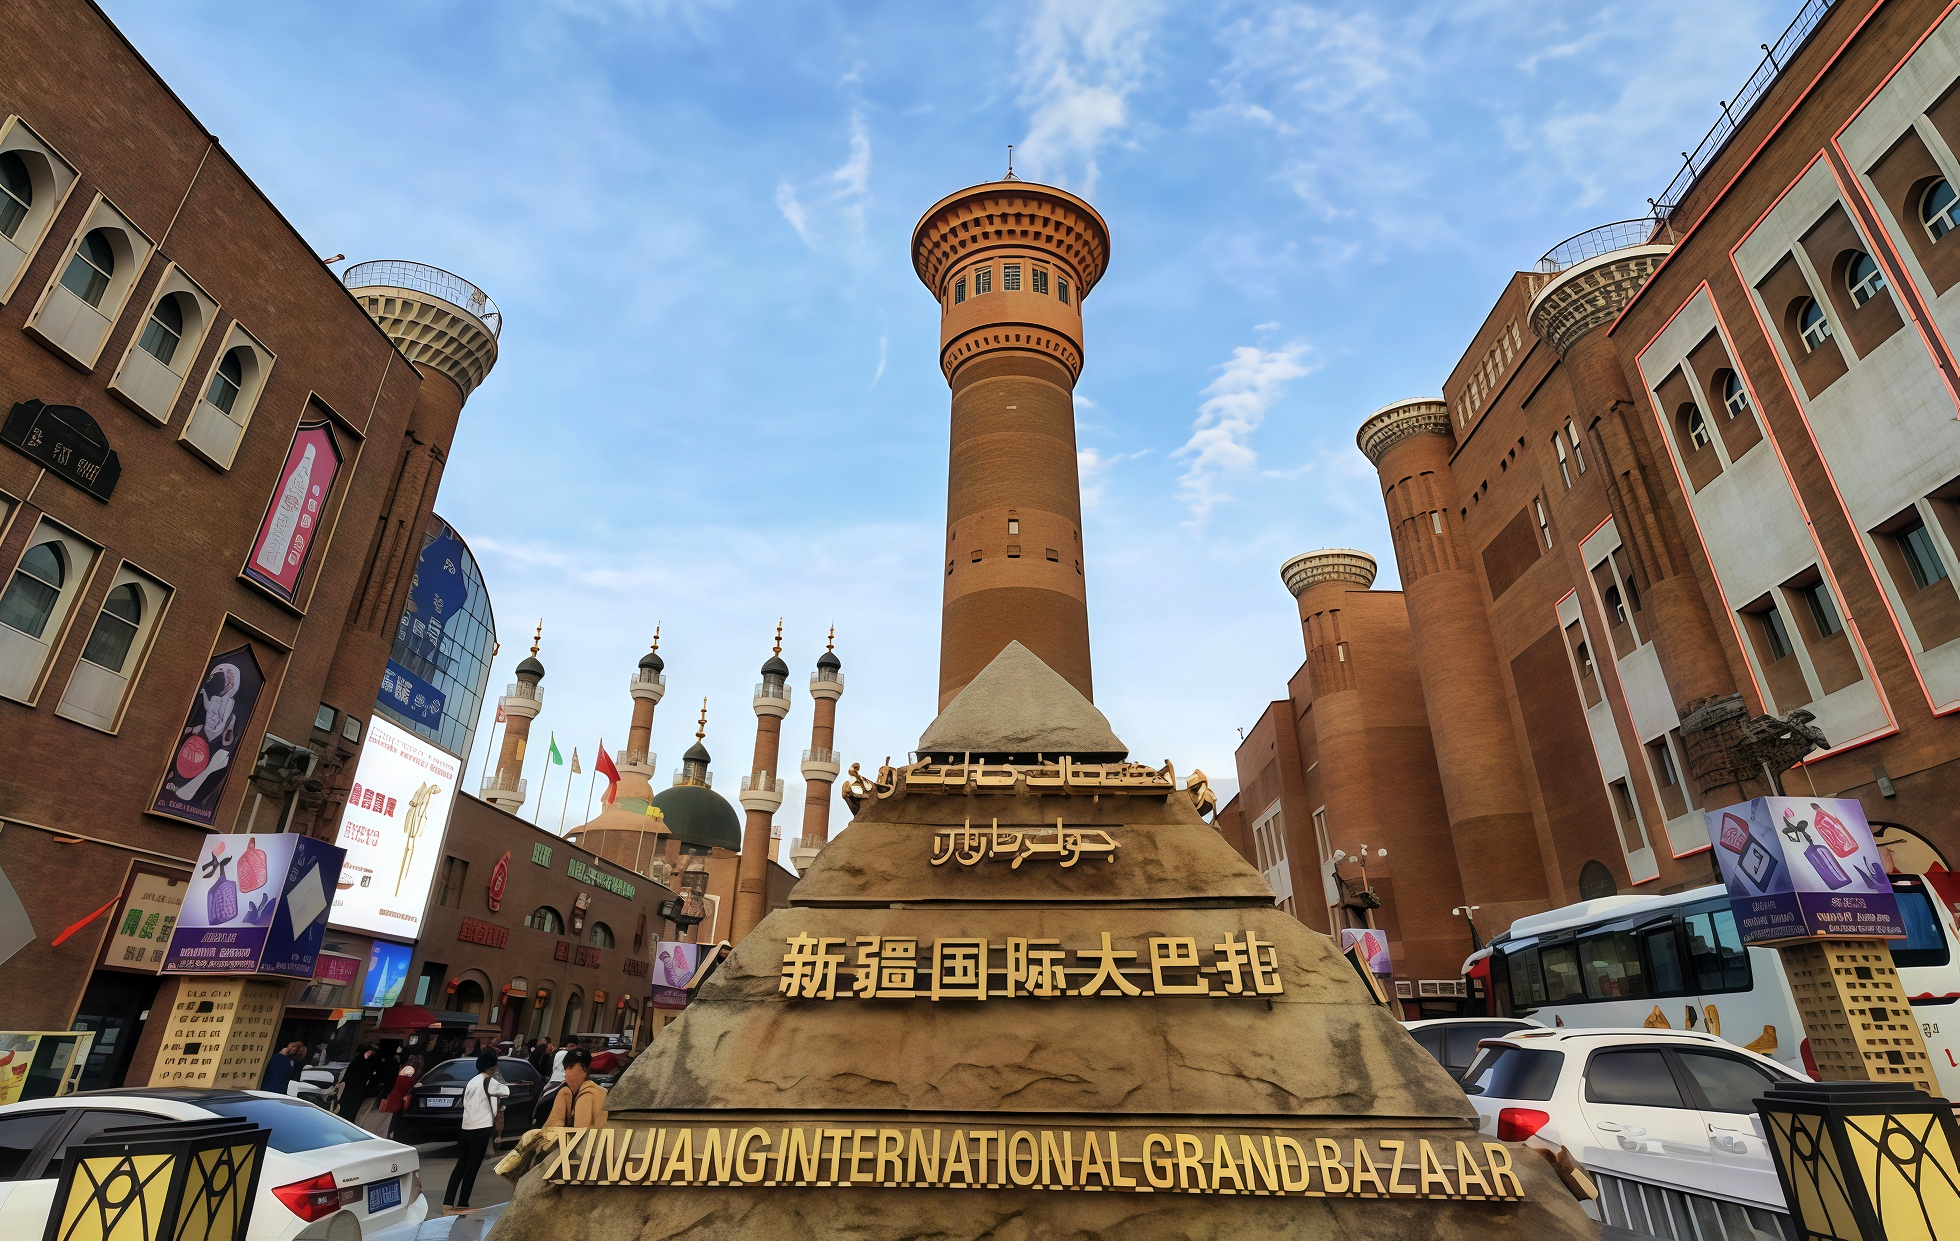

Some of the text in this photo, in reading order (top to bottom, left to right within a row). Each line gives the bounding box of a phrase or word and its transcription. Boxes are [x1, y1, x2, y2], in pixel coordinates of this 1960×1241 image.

[542, 1127, 1525, 1197] XINJIANG INTERNATIONAL GRAND BAZAAR
